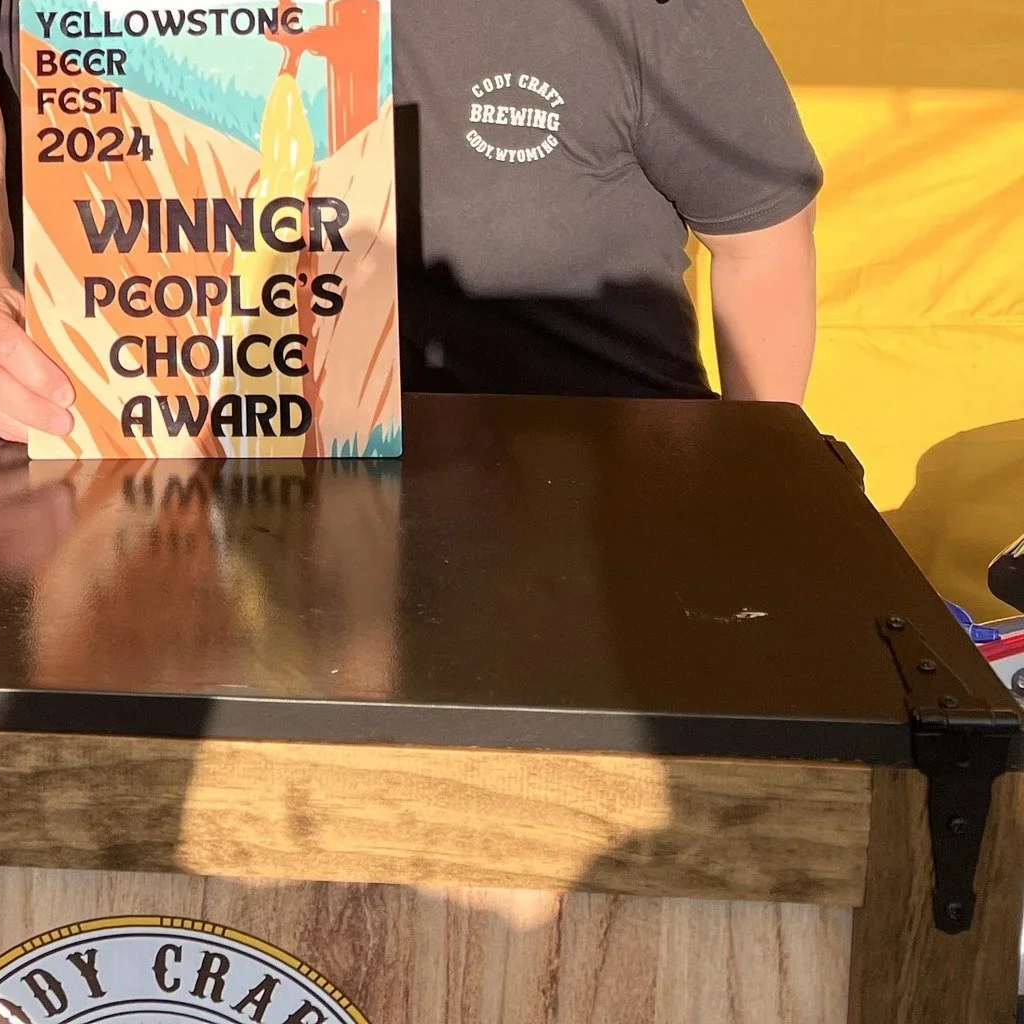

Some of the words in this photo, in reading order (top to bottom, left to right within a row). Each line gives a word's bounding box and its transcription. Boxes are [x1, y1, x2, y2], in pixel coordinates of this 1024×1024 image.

[36, 7, 304, 39] YELLOWSTONE
[36, 49, 127, 76] BEER
[36, 87, 124, 115] FEST
[471, 73, 512, 98] CODY
[518, 74, 565, 108] CRAFT
[469, 103, 561, 132] BREWING
[36, 127, 154, 163] 2024
[496, 134, 559, 163] WYOMING
[73, 197, 351, 254] WINNER
[84, 274, 344, 318] PEOPLE'S
[109, 333, 310, 378] CHOICE
[121, 394, 313, 438] AWARD
[152, 943, 330, 1024] CRAF
